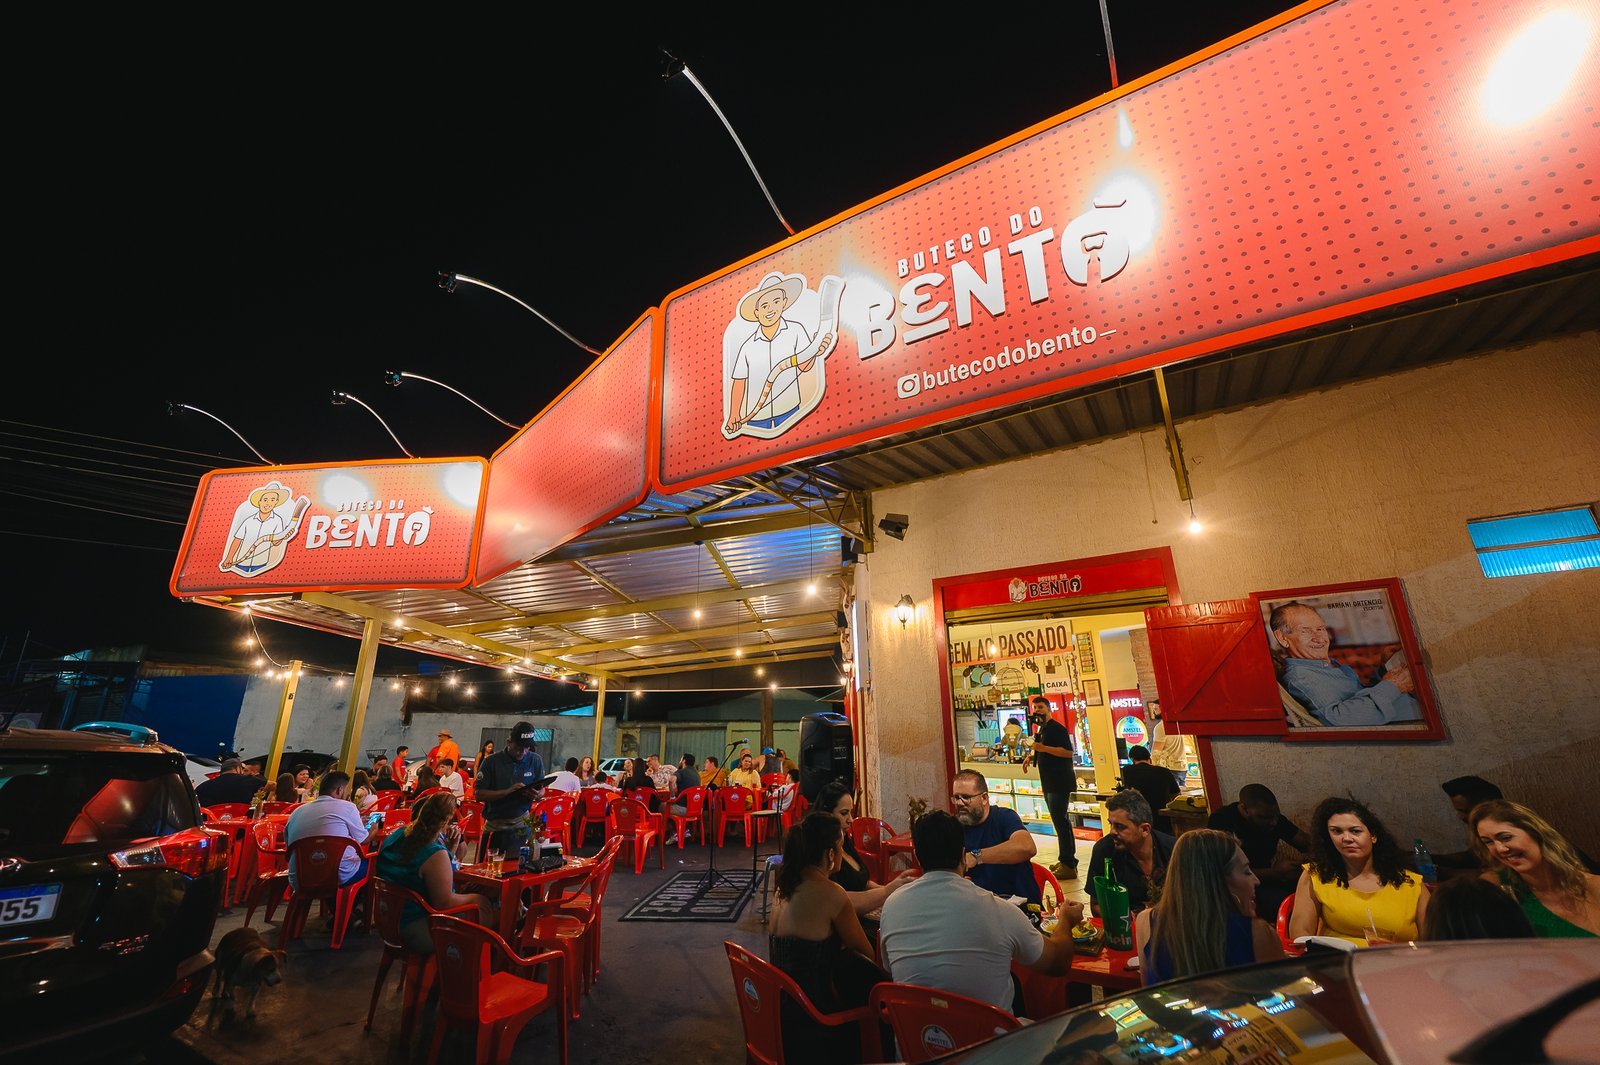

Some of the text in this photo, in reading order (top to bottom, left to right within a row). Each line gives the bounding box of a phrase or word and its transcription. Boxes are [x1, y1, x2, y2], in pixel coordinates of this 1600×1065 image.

[897, 206, 1043, 278] BUTECO DO
[389, 499, 405, 510] DO
[998, 625, 1068, 658] PASSADO
[1046, 681, 1068, 689] CAIXA
[1110, 697, 1142, 710] AMSTEL
